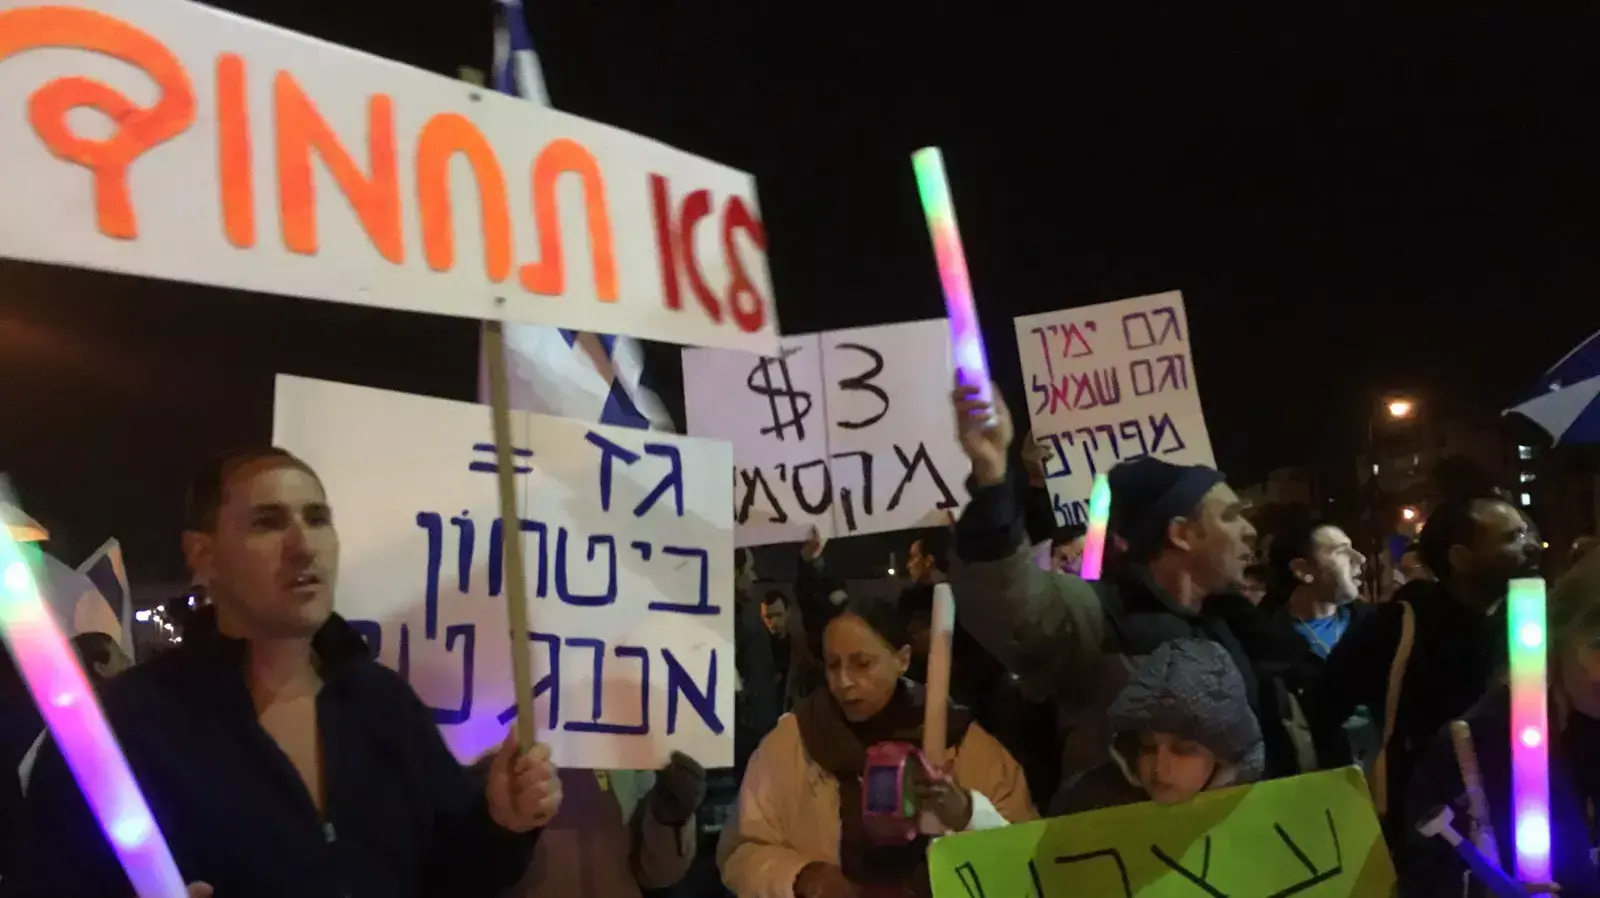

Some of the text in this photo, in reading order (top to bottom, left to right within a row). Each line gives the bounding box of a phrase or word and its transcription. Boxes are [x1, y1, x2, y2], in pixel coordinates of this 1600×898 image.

[648, 172, 767, 333] לא
[1031, 306, 1182, 379] גם ימין
[1032, 355, 1188, 415] וגם שמאל
[585, 430, 685, 517] גז
[733, 441, 958, 530] מקסימ
